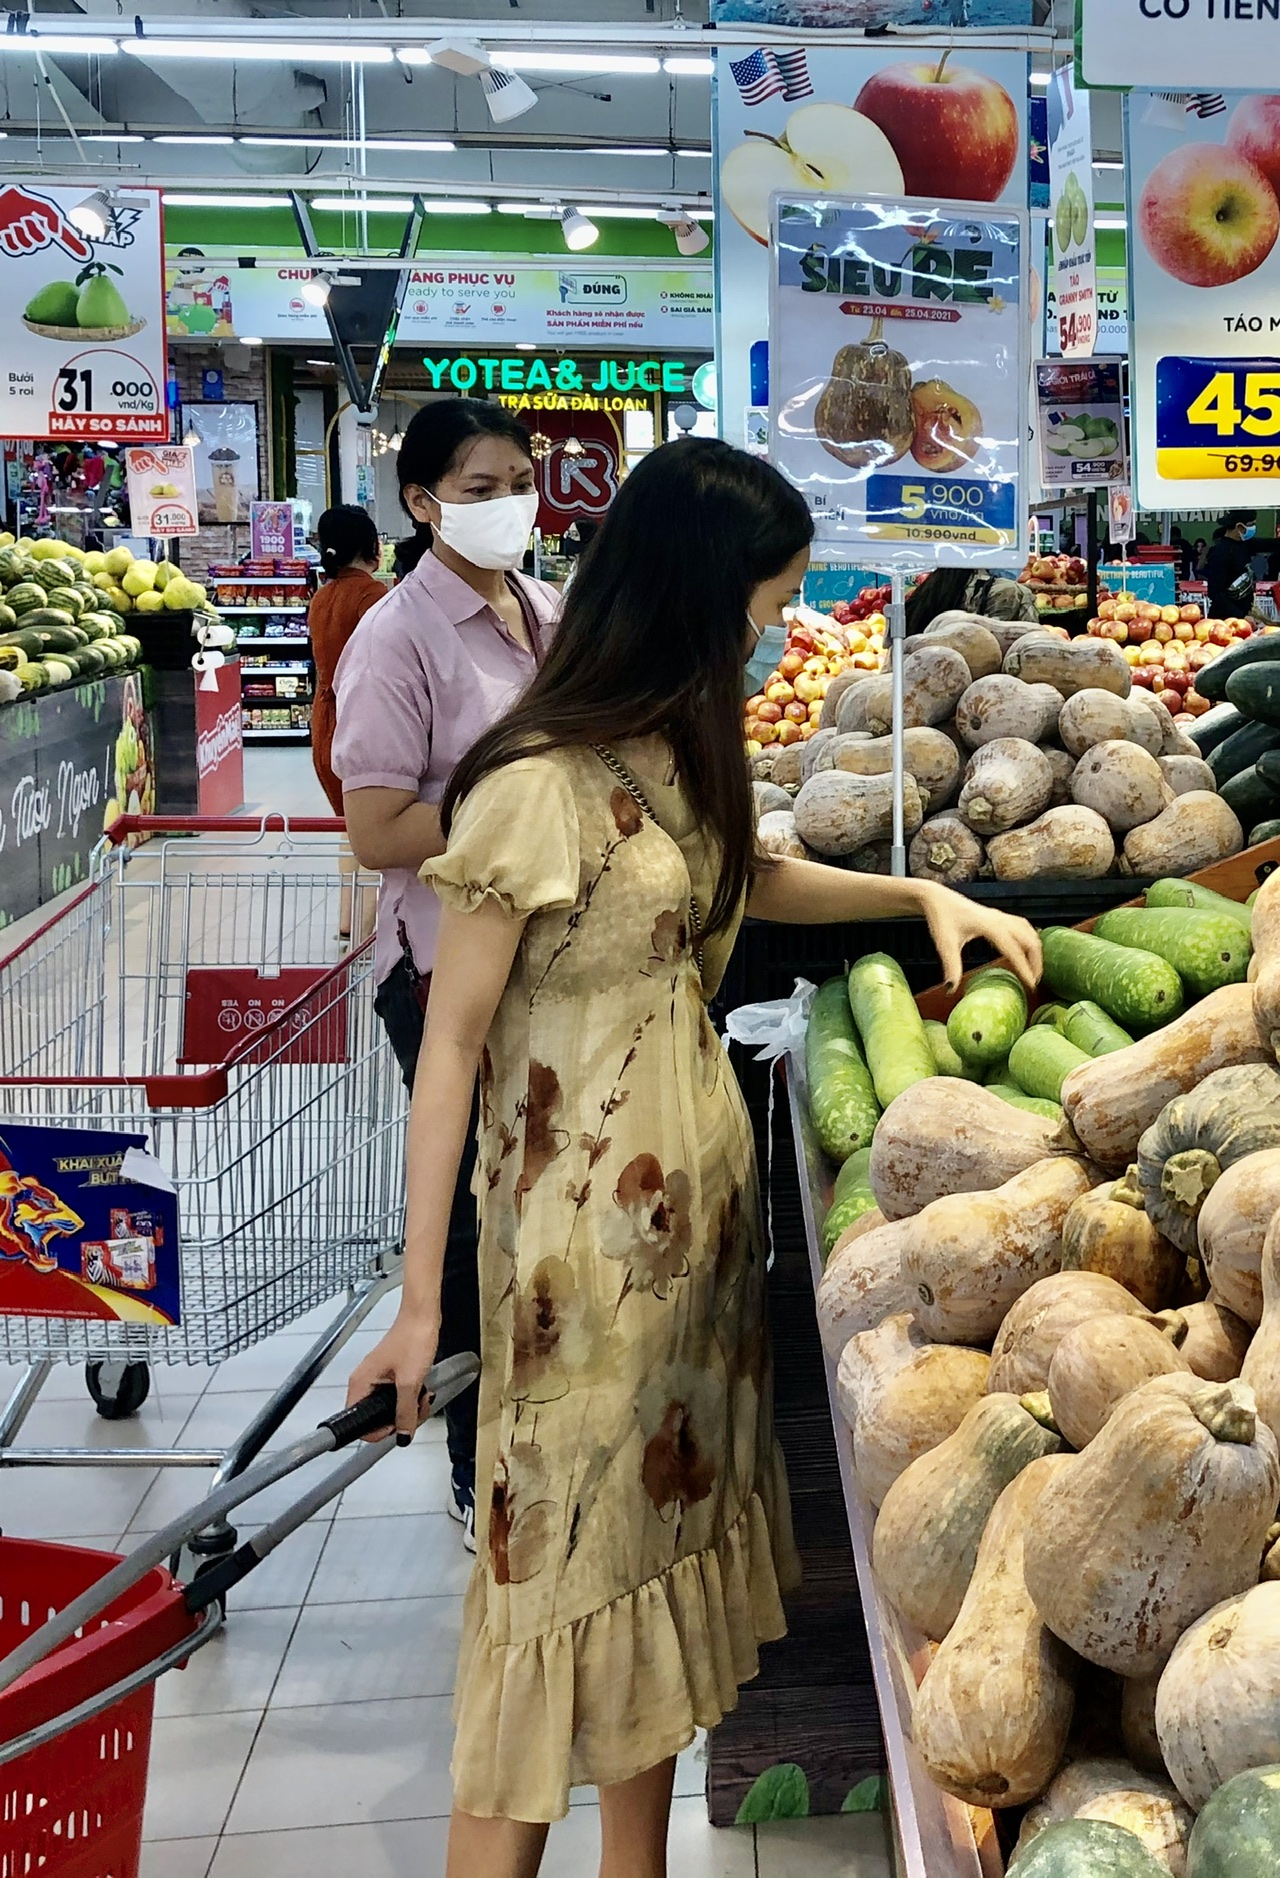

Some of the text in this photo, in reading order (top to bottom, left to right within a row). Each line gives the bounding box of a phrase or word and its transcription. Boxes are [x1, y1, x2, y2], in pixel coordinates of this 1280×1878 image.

[448, 272, 490, 287] PHỤC
[494, 274, 515, 288] VỤ
[408, 287, 516, 299] eady to serve you
[582, 281, 621, 295] ĐÚNG
[1097, 290, 1119, 303] TỪ
[862, 304, 887, 316] 23.04
[905, 308, 951, 320] 25.04.2021
[1223, 313, 1263, 332] TÁO
[8, 371, 34, 383] Bưởi
[591, 360, 686, 393] JUCE
[9, 386, 34, 396] 5 roi
[58, 368, 92, 412] 31
[118, 400, 154, 411] vnd/Kg
[571, 394, 599, 412] ĐÀI
[603, 396, 648, 412] LOAN
[51, 415, 162, 432] HÃY SO SÁNH
[814, 495, 827, 506] BÍ
[155, 513, 170, 526] 31
[259, 535, 286, 545] 1900
[906, 527, 977, 541] 10.900vnd
[260, 544, 285, 553] 1880
[1131, 569, 1165, 579] BEAUTIFUL
[221, 999, 285, 1007] YES NO NO
[59, 1153, 124, 1171] KHAI XUÂ
